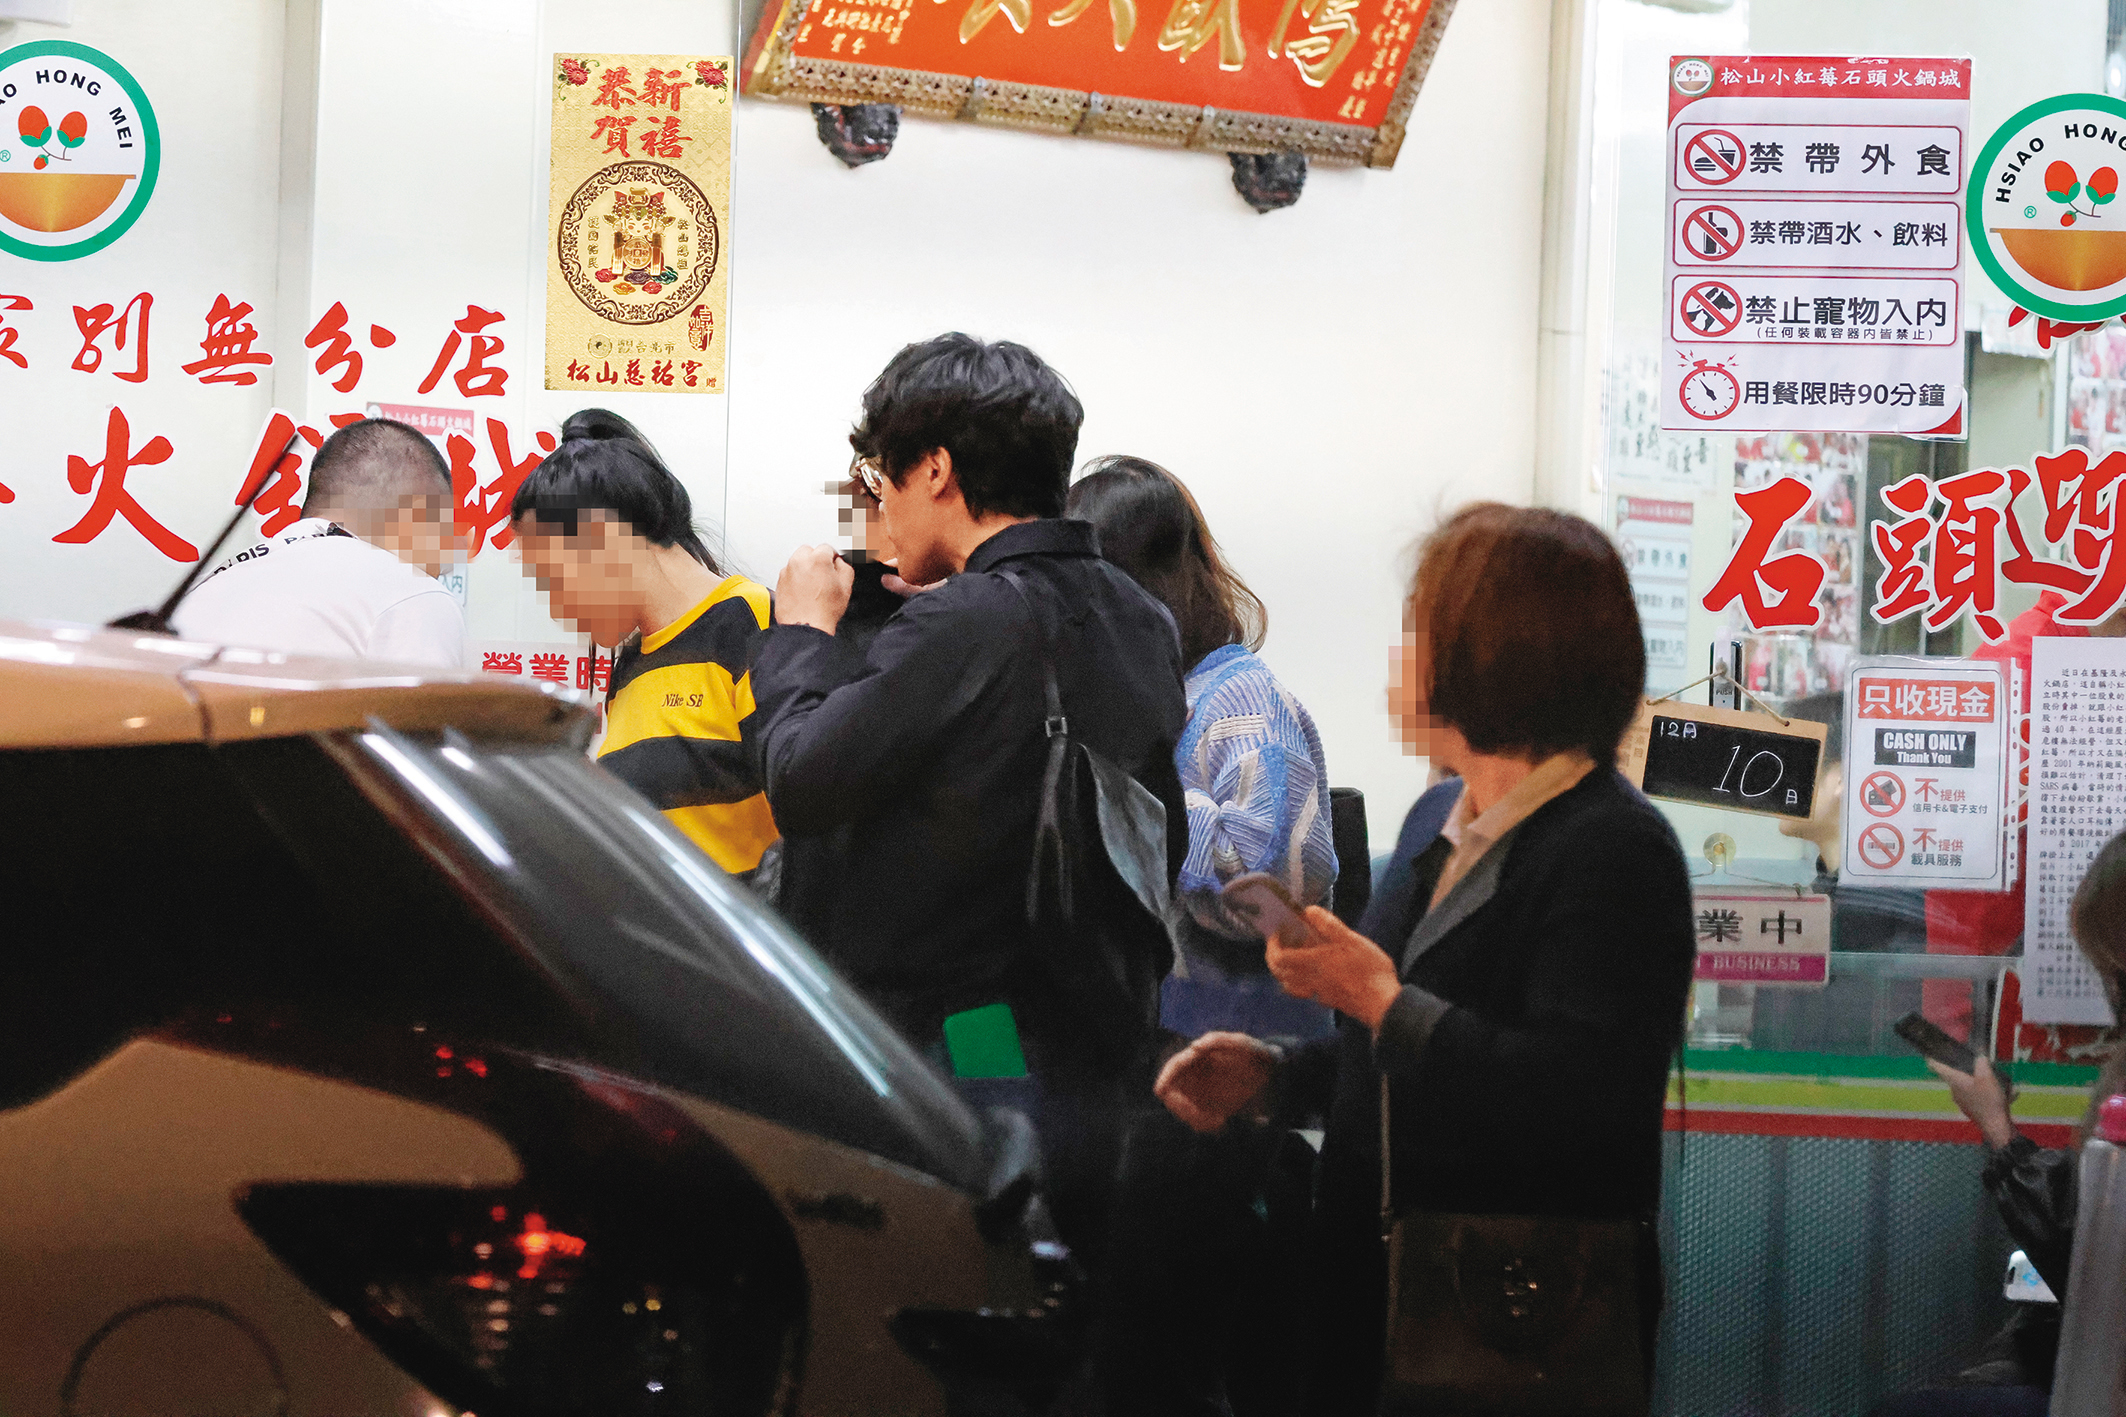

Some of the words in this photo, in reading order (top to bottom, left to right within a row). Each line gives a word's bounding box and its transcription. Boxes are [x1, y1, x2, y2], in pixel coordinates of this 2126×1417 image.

[1720, 67, 1961, 89] 松山小紅莓石頭火鍋城
[35, 69, 102, 97] HONG
[109, 106, 133, 149] MEI
[1749, 142, 1951, 176] 禁帶外食
[1995, 137, 2045, 204] HSIAO
[1749, 220, 1948, 247] 禁帶酒水、飲料
[567, 358, 703, 387] 松山慈祐宮
[1743, 381, 1946, 407] 用餐限時90分鐘
[661, 693, 684, 707] Nike
[686, 693, 704, 707] SB
[1862, 684, 1991, 717] 只收現金
[1883, 732, 1925, 750] CASH
[1928, 733, 1968, 751] ONLY
[1896, 752, 1930, 764] Thank
[1931, 752, 1952, 765] You
[1712, 745, 1784, 798] 10
[1914, 777, 1966, 802] 不提供
[1912, 803, 1988, 815] 信用卡&電子支付
[1912, 827, 1964, 852] 不提供
[1911, 853, 1962, 867] 載具服務
[1713, 955, 1801, 971] BUSINESS
